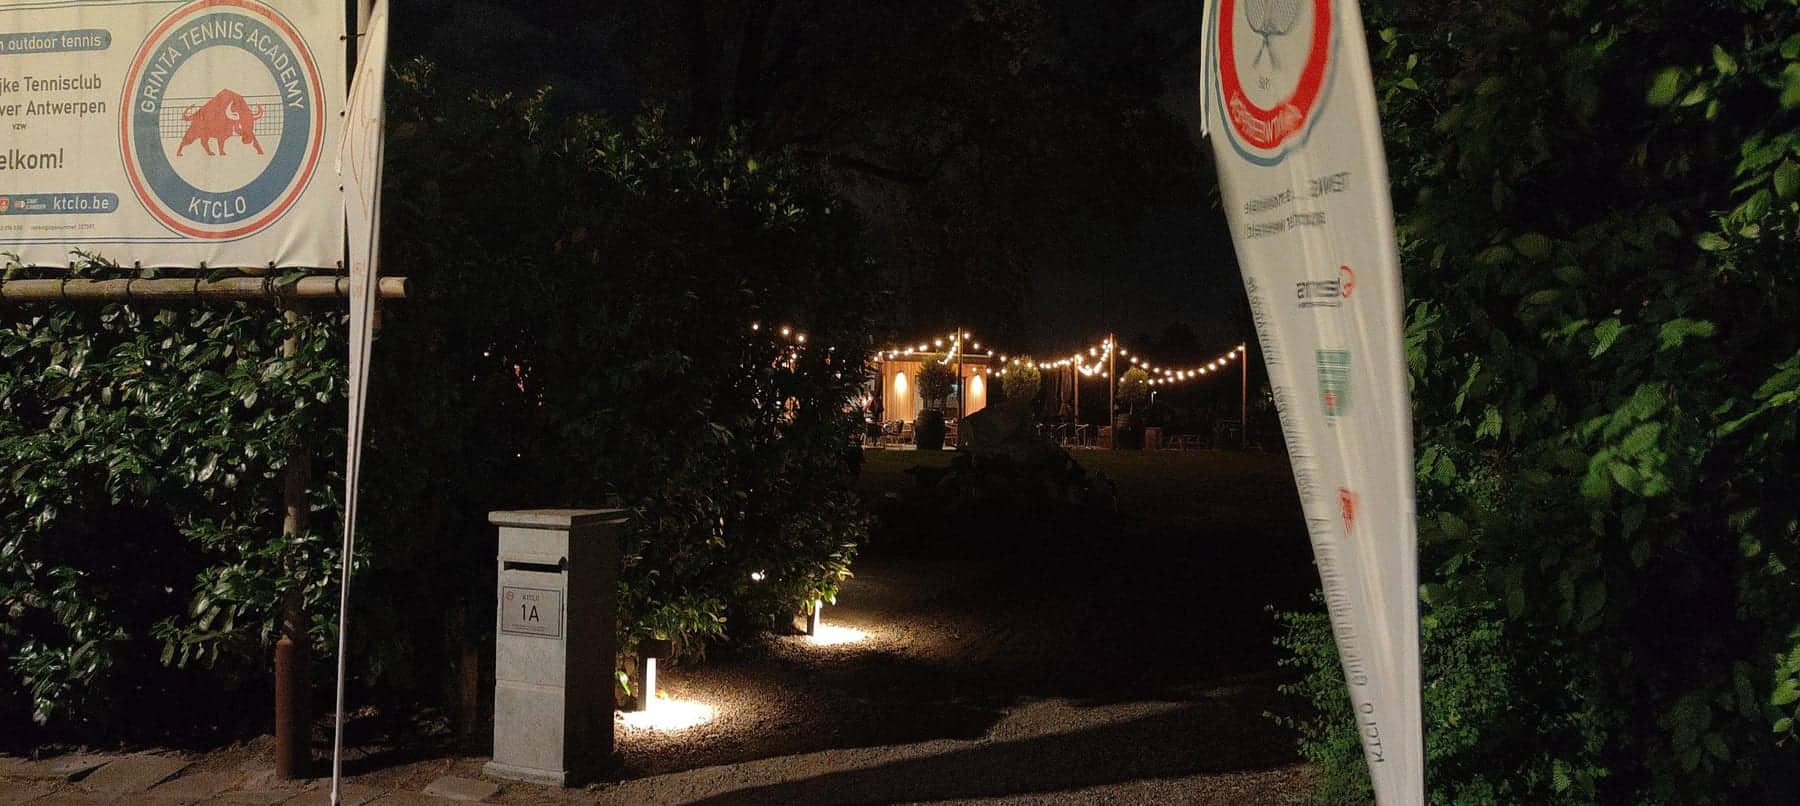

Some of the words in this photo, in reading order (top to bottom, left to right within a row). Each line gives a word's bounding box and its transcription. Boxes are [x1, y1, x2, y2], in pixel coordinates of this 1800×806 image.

[9, 36, 57, 50] outdoor
[61, 33, 101, 48] tennis
[141, 46, 180, 113] GRINTA
[179, 21, 245, 50] TENNIS
[246, 29, 304, 110] ACADEMY
[24, 74, 102, 92] Tennisclub
[26, 101, 106, 118] Antwerpen
[0, 148, 64, 170] elkom!
[53, 195, 109, 211] ktclo.be
[188, 196, 247, 218] KTCLO
[521, 604, 540, 622] 1A
